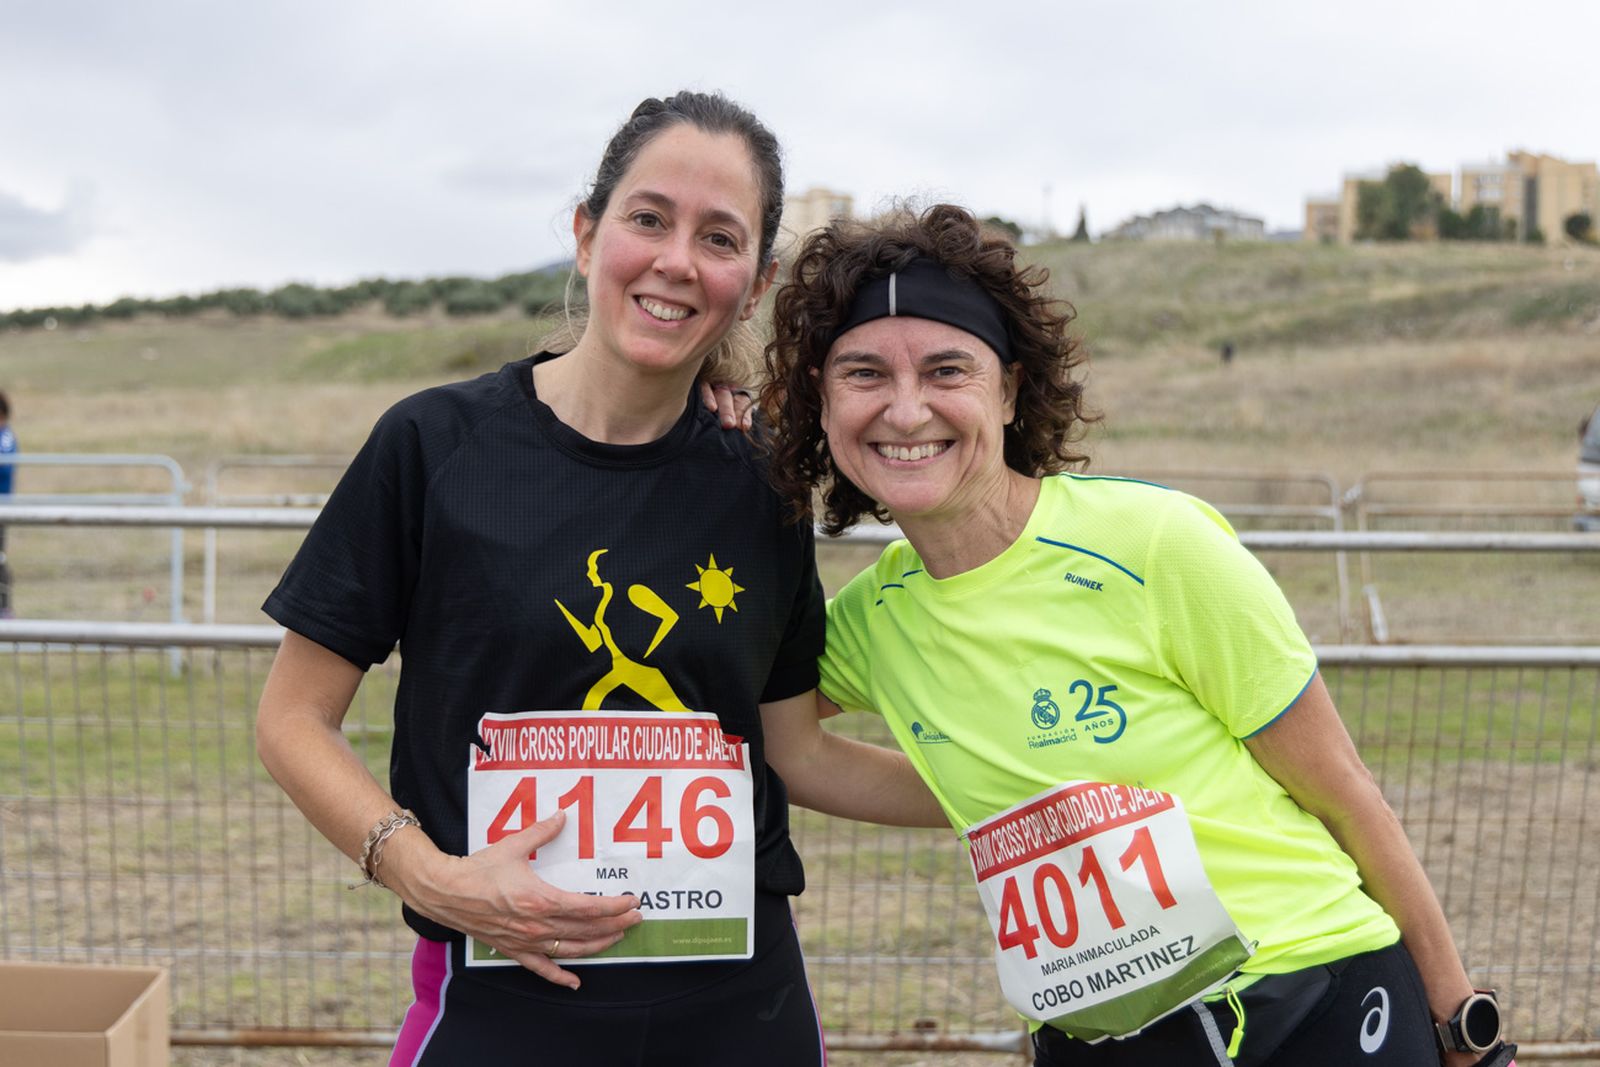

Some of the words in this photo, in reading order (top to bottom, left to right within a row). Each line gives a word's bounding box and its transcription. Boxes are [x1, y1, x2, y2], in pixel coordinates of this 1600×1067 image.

[1064, 572, 1103, 592] RUNNEK
[1068, 679, 1127, 744] 25
[1084, 718, 1114, 732] AÑOS
[519, 726, 566, 761] CROSS
[568, 725, 629, 761] POPULAR
[633, 726, 681, 761] CIUDAD
[685, 726, 703, 761] DE
[487, 775, 735, 861] 4146
[991, 820, 1026, 864] CROSS
[1019, 805, 1064, 852] POPULAR
[1055, 789, 1105, 836] CIUDAD
[1100, 784, 1128, 820] DE
[596, 867, 628, 880] MAR
[998, 826, 1178, 961] 4011
[1031, 980, 1085, 1012] COBO
[1089, 935, 1201, 994] MARTINEZ
[1040, 954, 1077, 977] MARIA
[1076, 925, 1161, 963] INMACULADA
